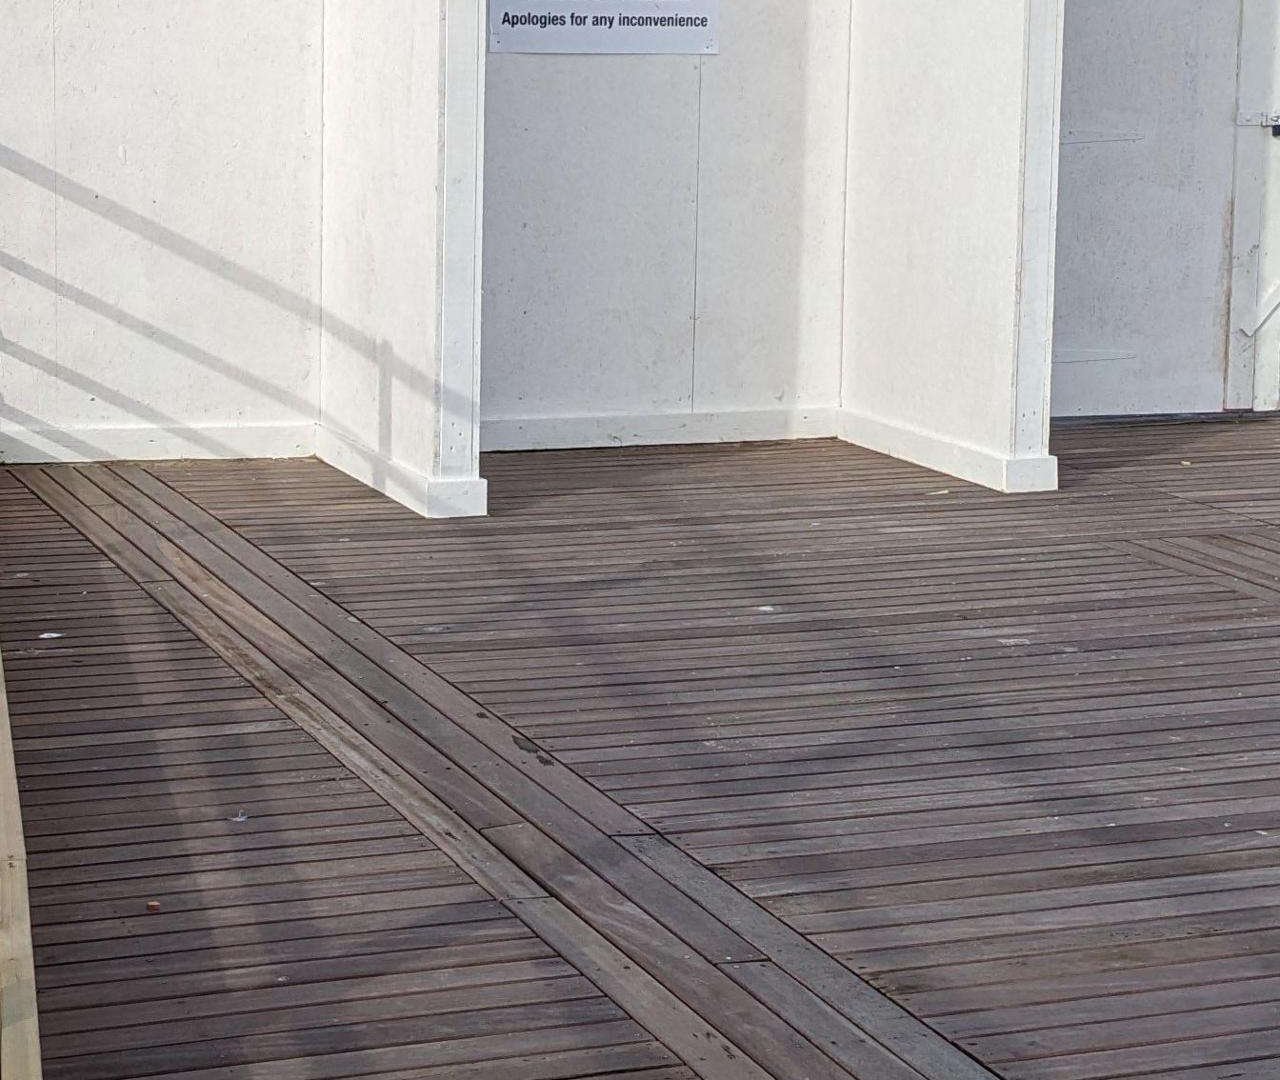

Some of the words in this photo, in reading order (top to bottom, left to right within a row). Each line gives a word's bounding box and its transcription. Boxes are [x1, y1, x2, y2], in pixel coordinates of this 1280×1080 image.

[502, 12, 566, 28] Apologies
[570, 13, 588, 26] for
[592, 16, 614, 29] any
[619, 13, 707, 27] inconvenience
